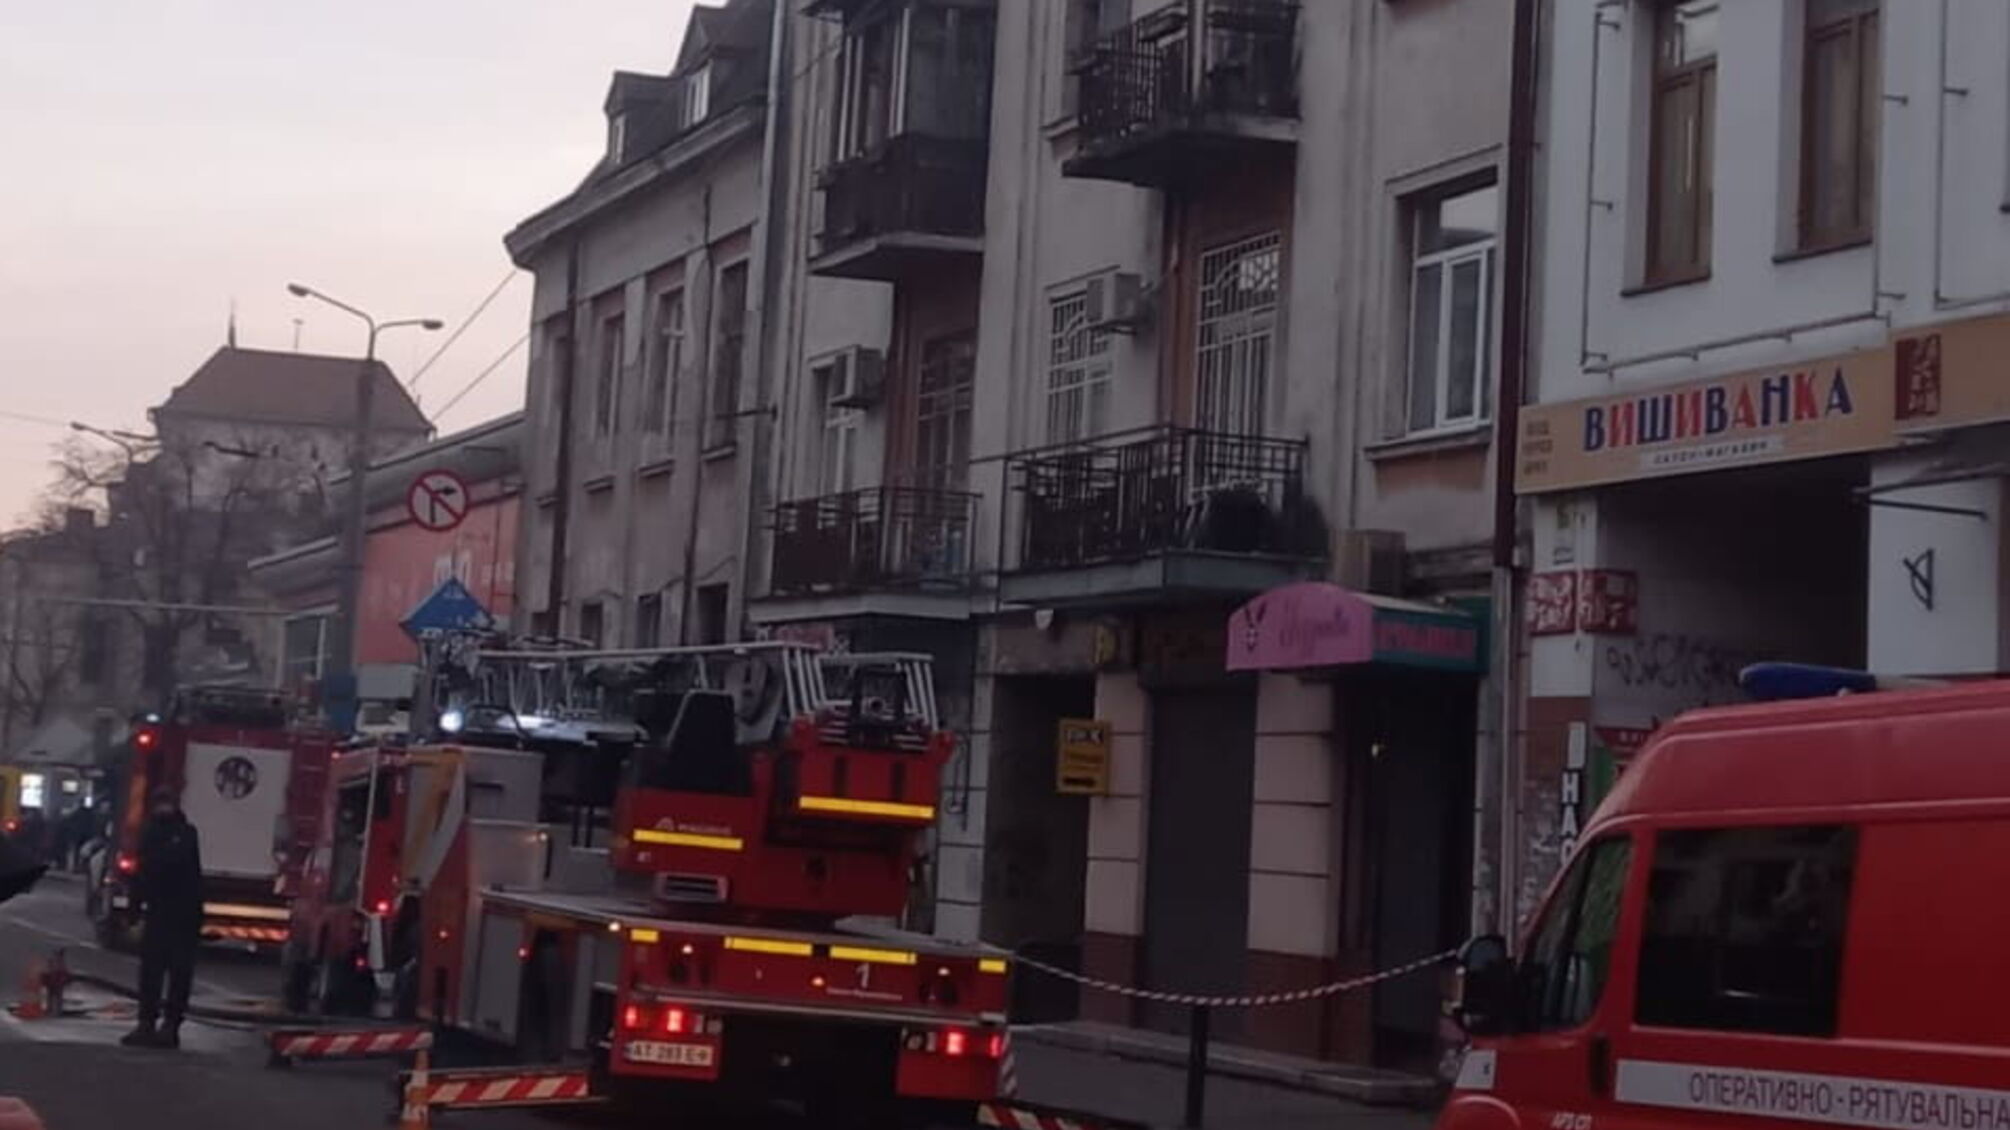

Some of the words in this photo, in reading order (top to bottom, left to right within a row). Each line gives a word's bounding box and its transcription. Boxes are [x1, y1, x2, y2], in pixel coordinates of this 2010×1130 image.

[1583, 366, 1854, 452] ВИШИВАНКА
[855, 962, 870, 989] 1
[1688, 1071, 1833, 1115] ОПЕРАТИВНО
